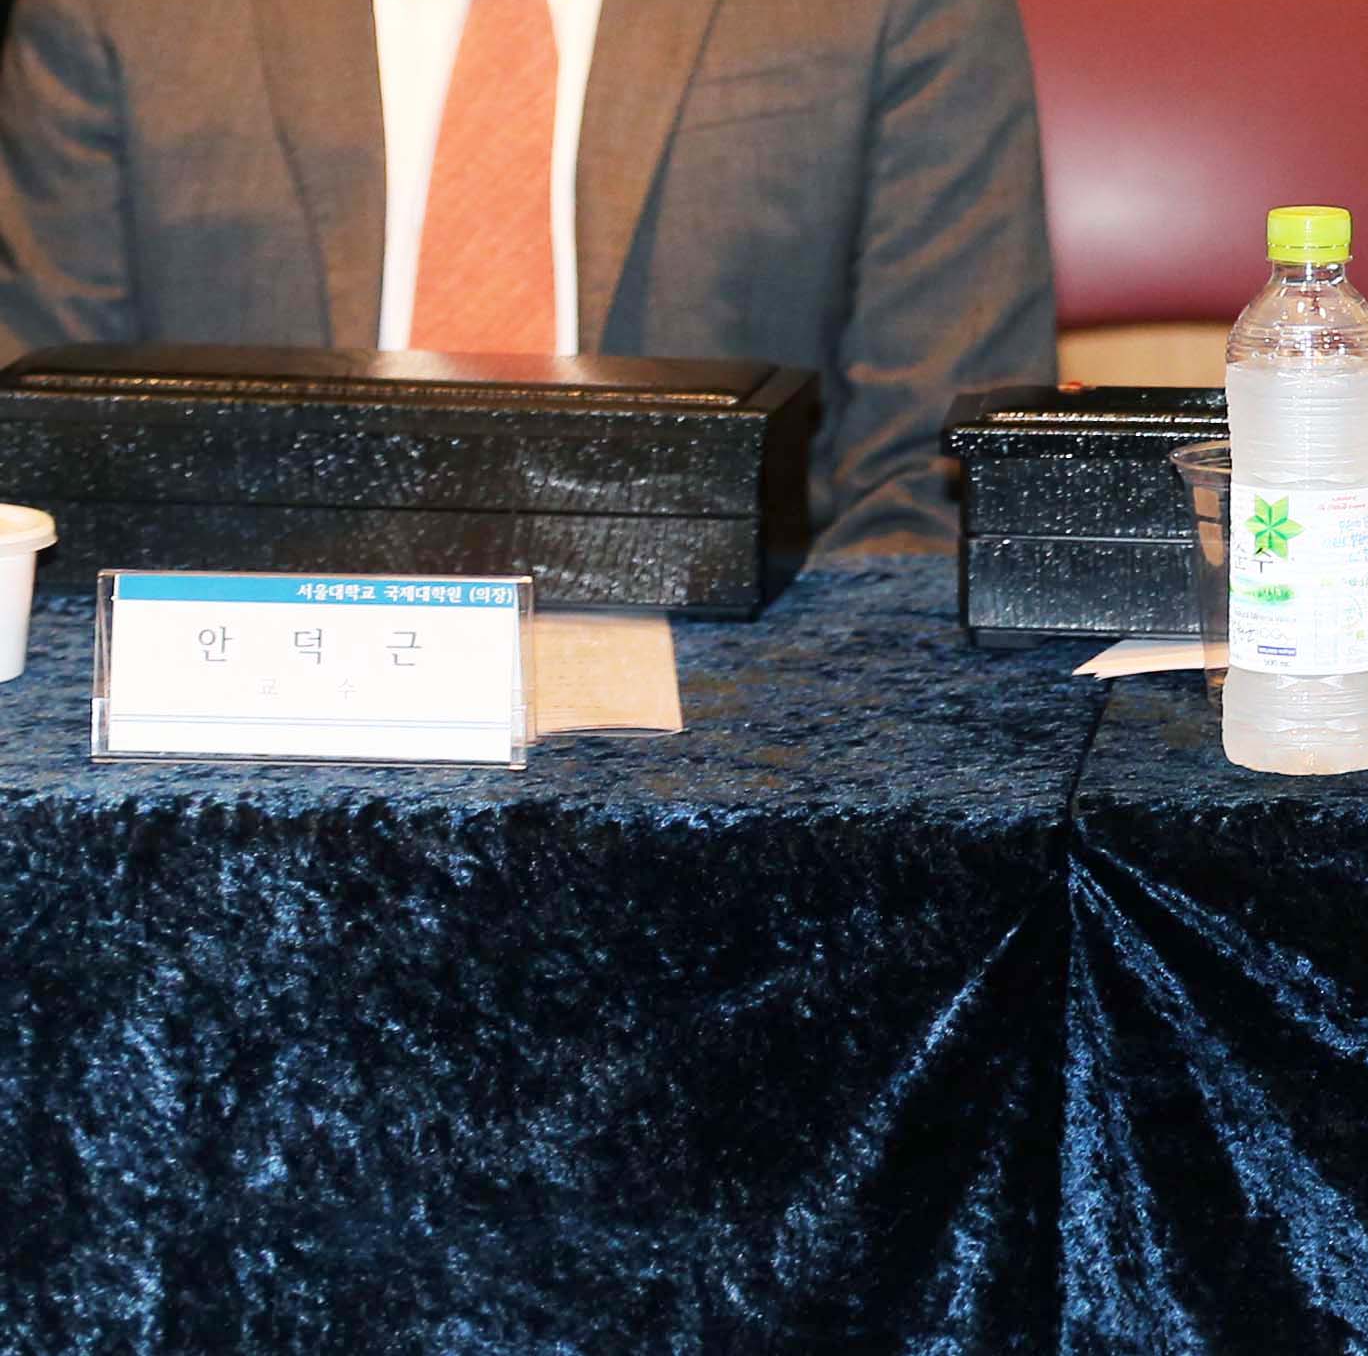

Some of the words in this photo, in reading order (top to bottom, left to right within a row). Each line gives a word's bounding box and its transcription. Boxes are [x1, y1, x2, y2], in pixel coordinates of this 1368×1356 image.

[297, 582, 377, 601] 서울대학교
[383, 585, 462, 603] 국제대학원
[468, 586, 514, 605] (의장)
